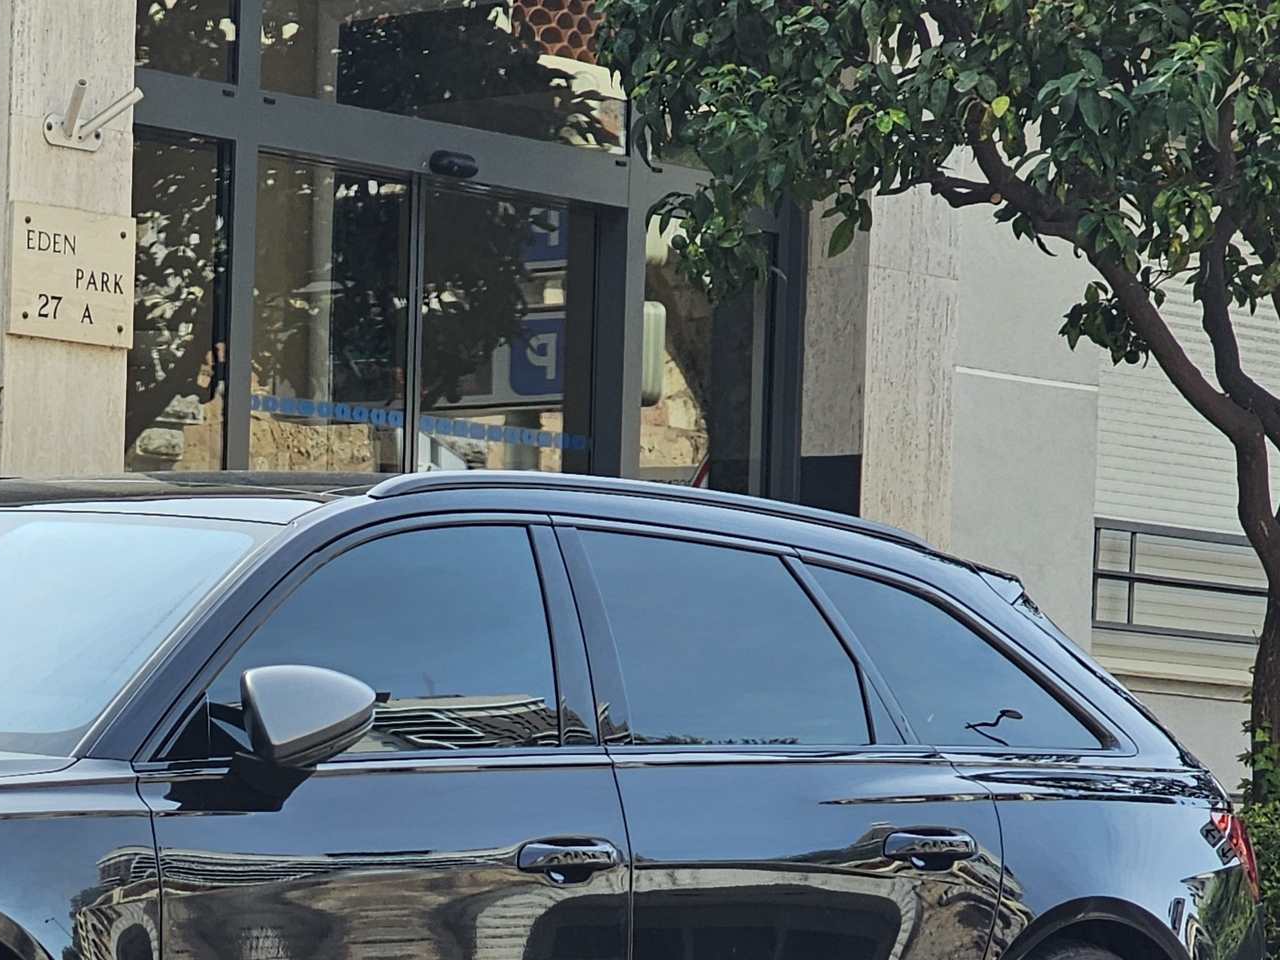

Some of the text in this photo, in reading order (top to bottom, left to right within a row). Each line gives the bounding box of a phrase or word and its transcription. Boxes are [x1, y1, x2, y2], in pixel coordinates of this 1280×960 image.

[26, 229, 76, 255] EDEN
[75, 268, 124, 295] PARK
[38, 293, 94, 325] 27 A
